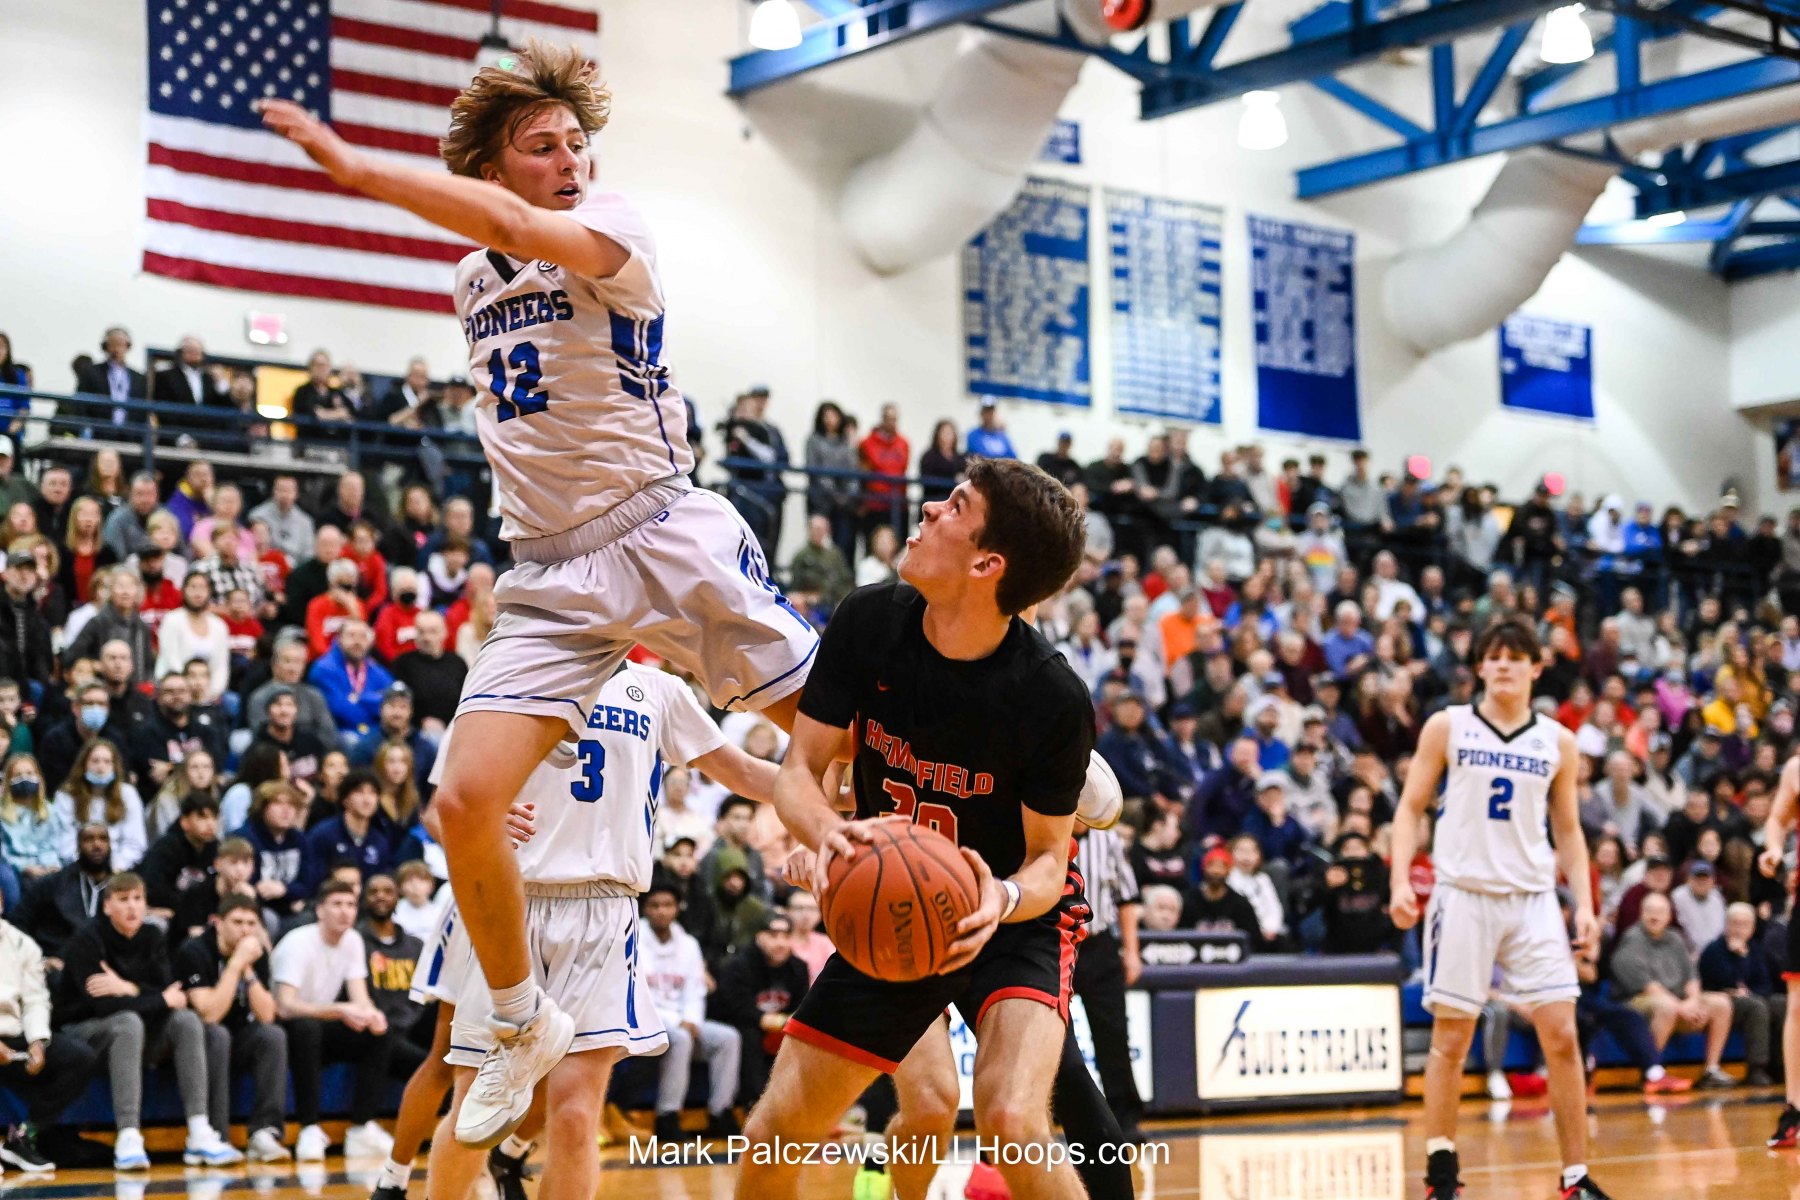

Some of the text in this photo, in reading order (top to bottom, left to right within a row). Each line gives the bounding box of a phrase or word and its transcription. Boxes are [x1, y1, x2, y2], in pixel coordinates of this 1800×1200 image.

[487, 341, 549, 423] 12
[630, 689, 640, 699] 15
[587, 704, 651, 742] EERS
[570, 739, 606, 803] 3
[1457, 749, 1551, 777] PIONEERS
[1488, 777, 1514, 821] 2
